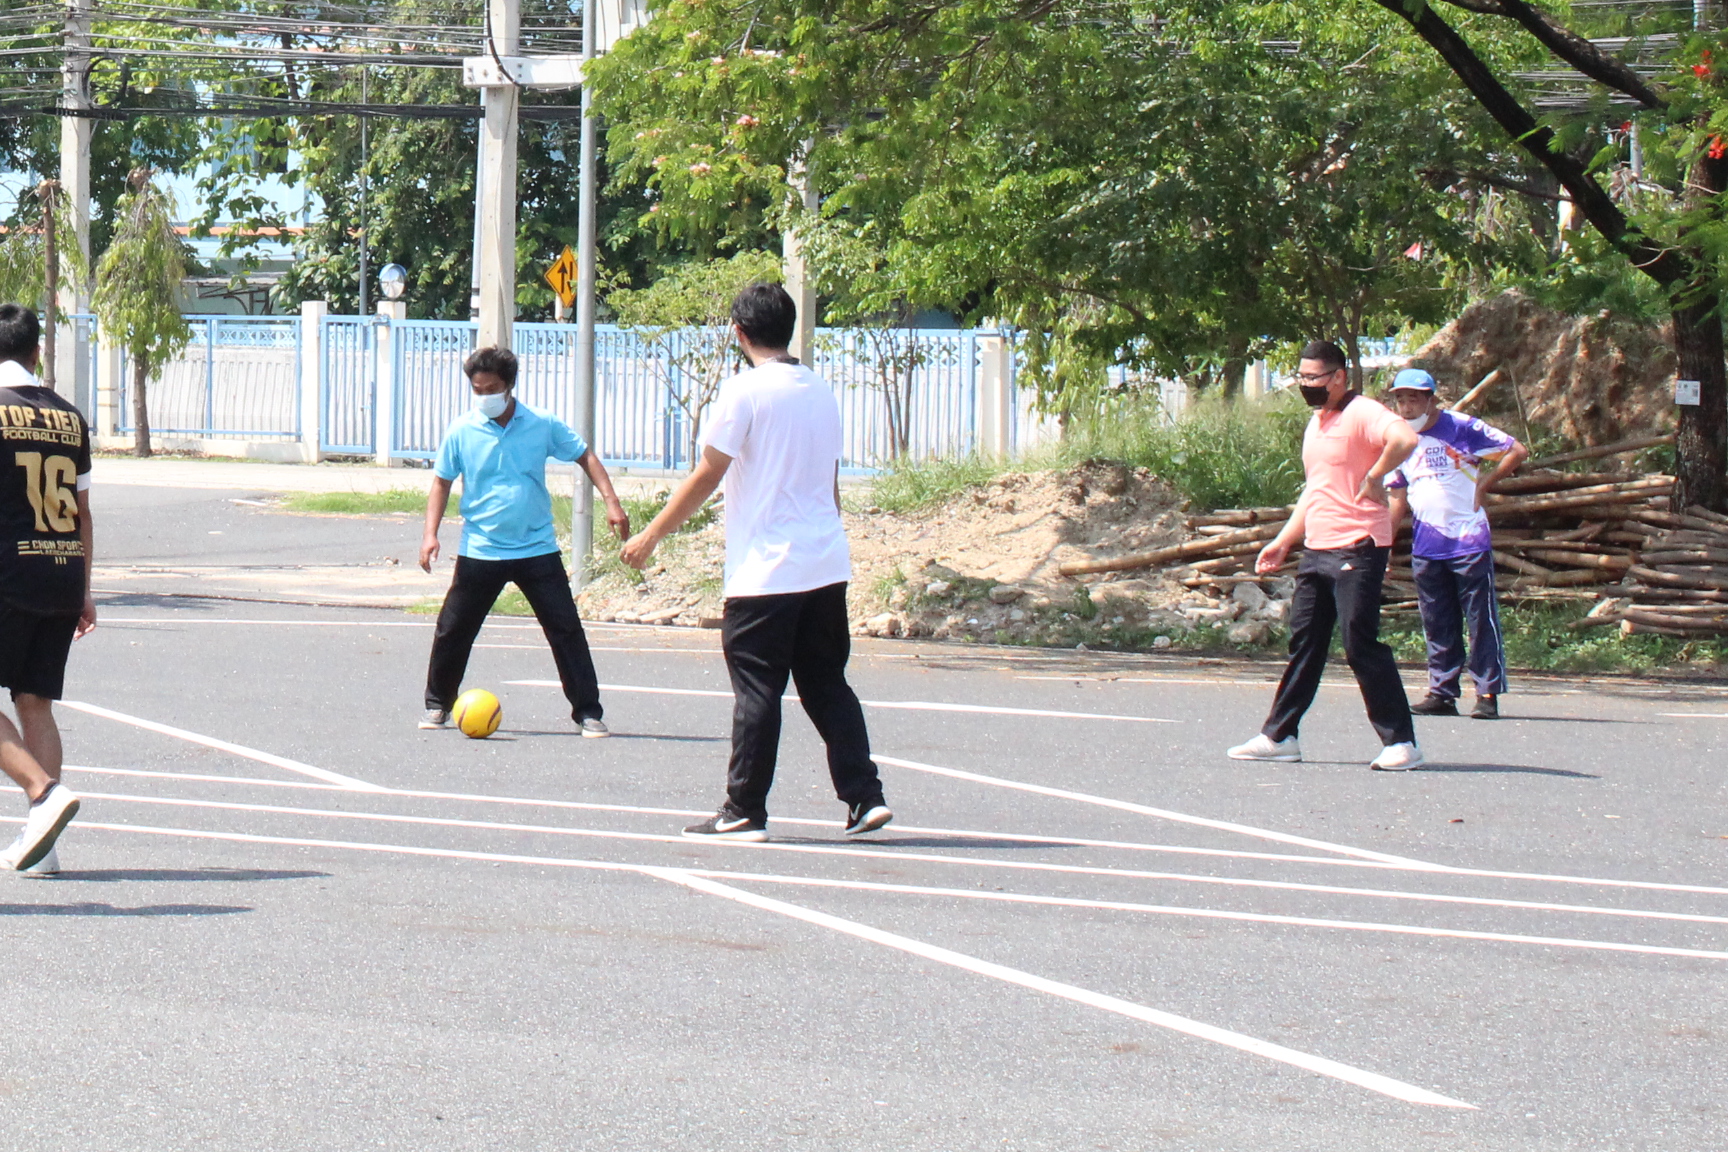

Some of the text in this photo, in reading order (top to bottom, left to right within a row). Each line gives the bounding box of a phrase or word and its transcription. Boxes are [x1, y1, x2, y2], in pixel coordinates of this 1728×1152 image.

[39, 408, 81, 434] TIER
[2, 430, 81, 447] FOOTBALL CLUB
[15, 451, 78, 533] 16
[32, 540, 56, 550] CHON
